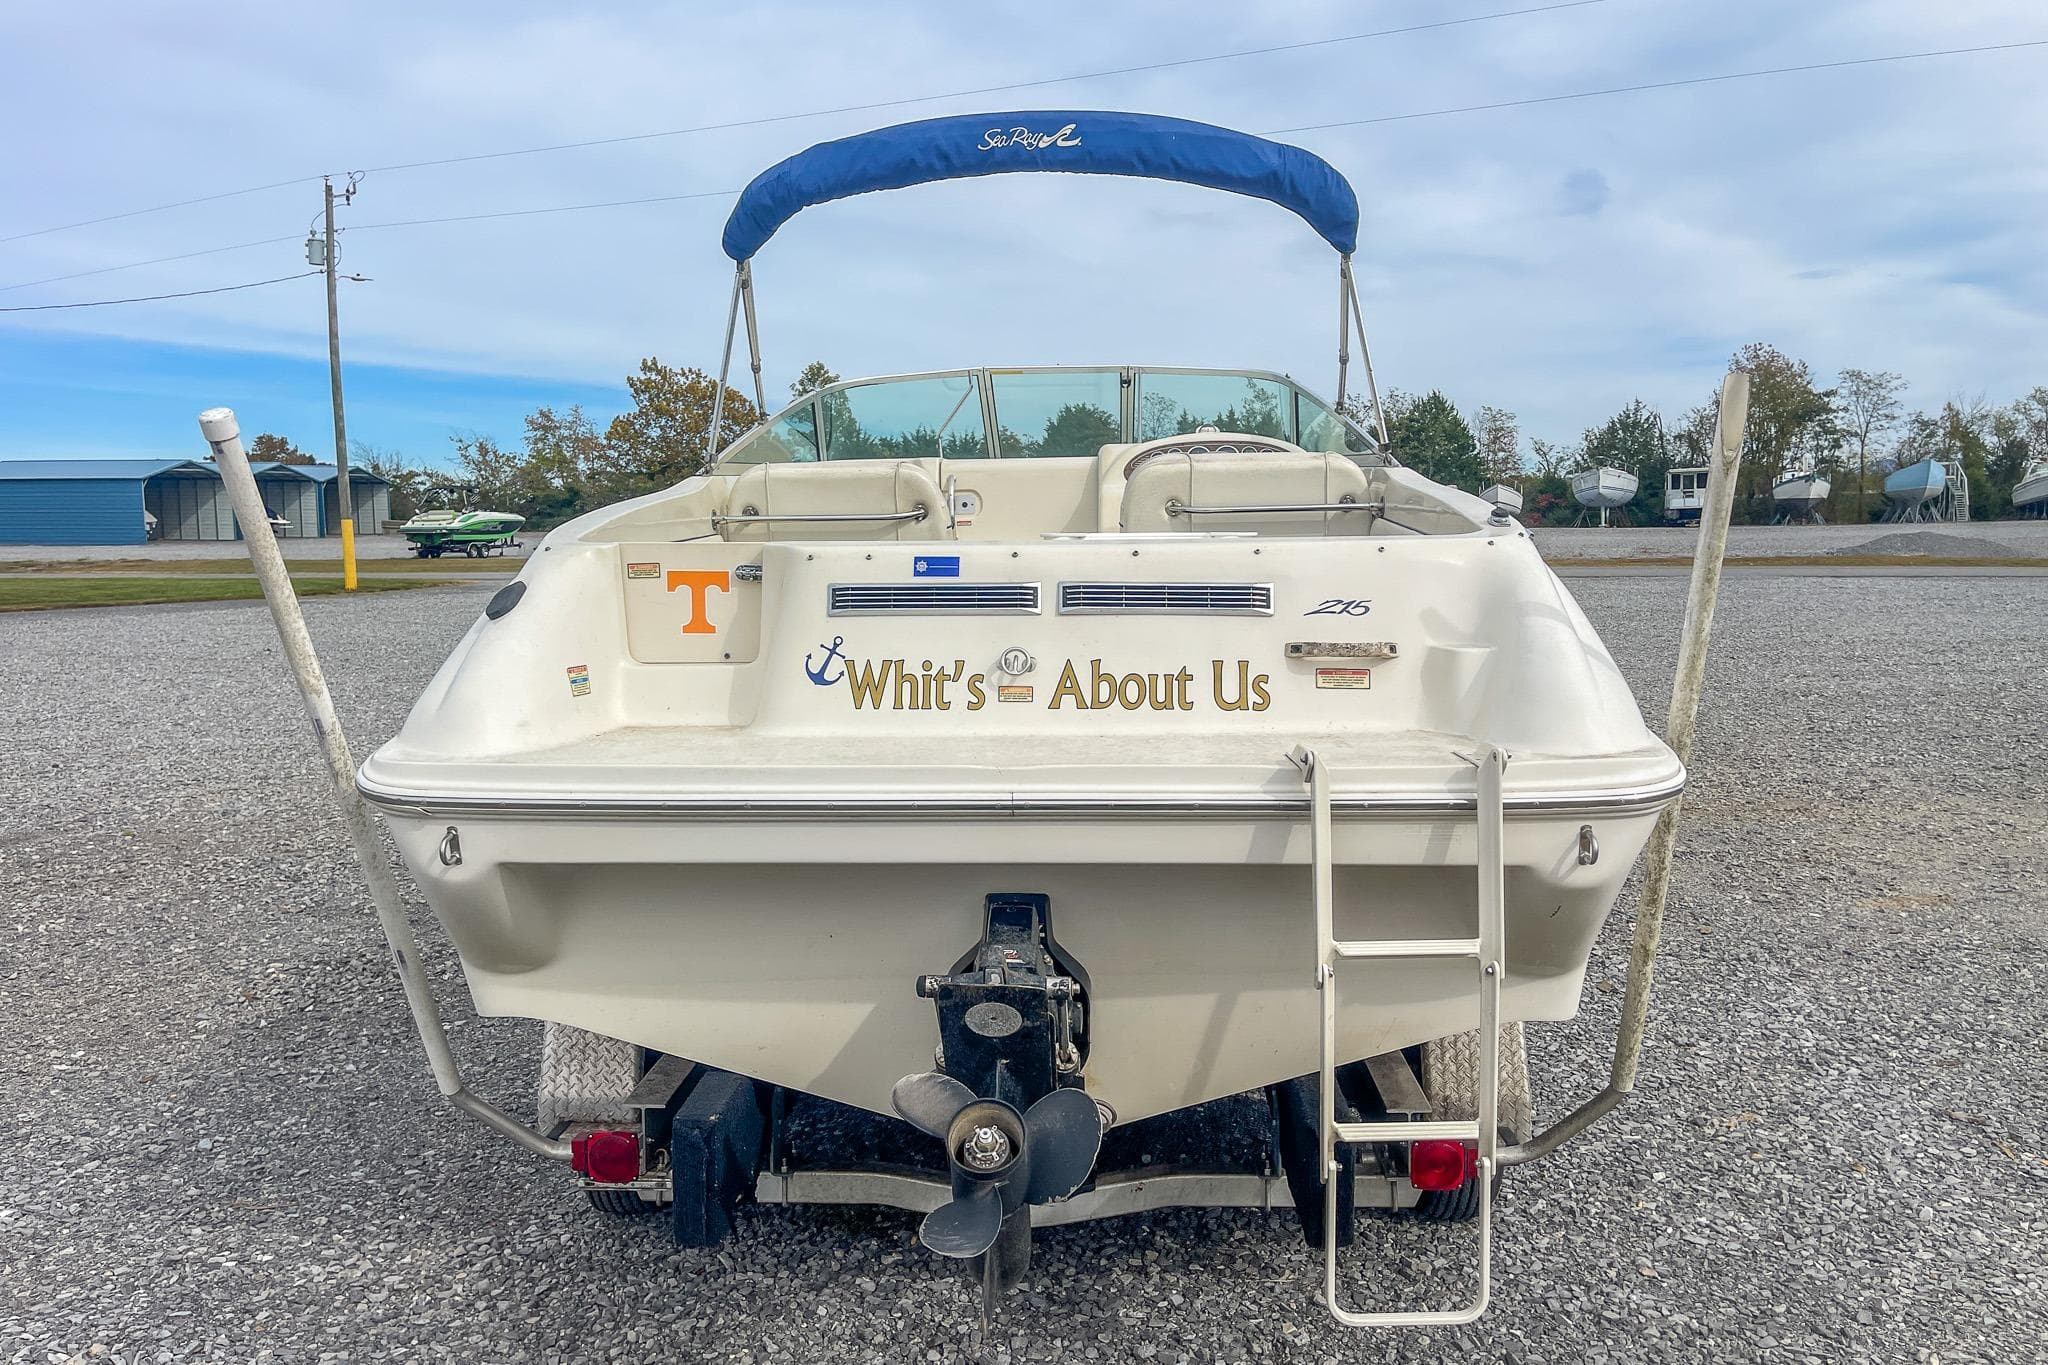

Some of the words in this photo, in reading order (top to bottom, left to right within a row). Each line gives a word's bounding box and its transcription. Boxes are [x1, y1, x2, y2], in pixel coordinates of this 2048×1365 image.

[977, 128, 1009, 150] Sea
[1009, 126, 1043, 150] Ray
[666, 569, 731, 635] T
[1304, 599, 1372, 617] 215
[844, 658, 985, 711] Whit's
[1048, 658, 1194, 711] About
[1211, 659, 1271, 711] Us
